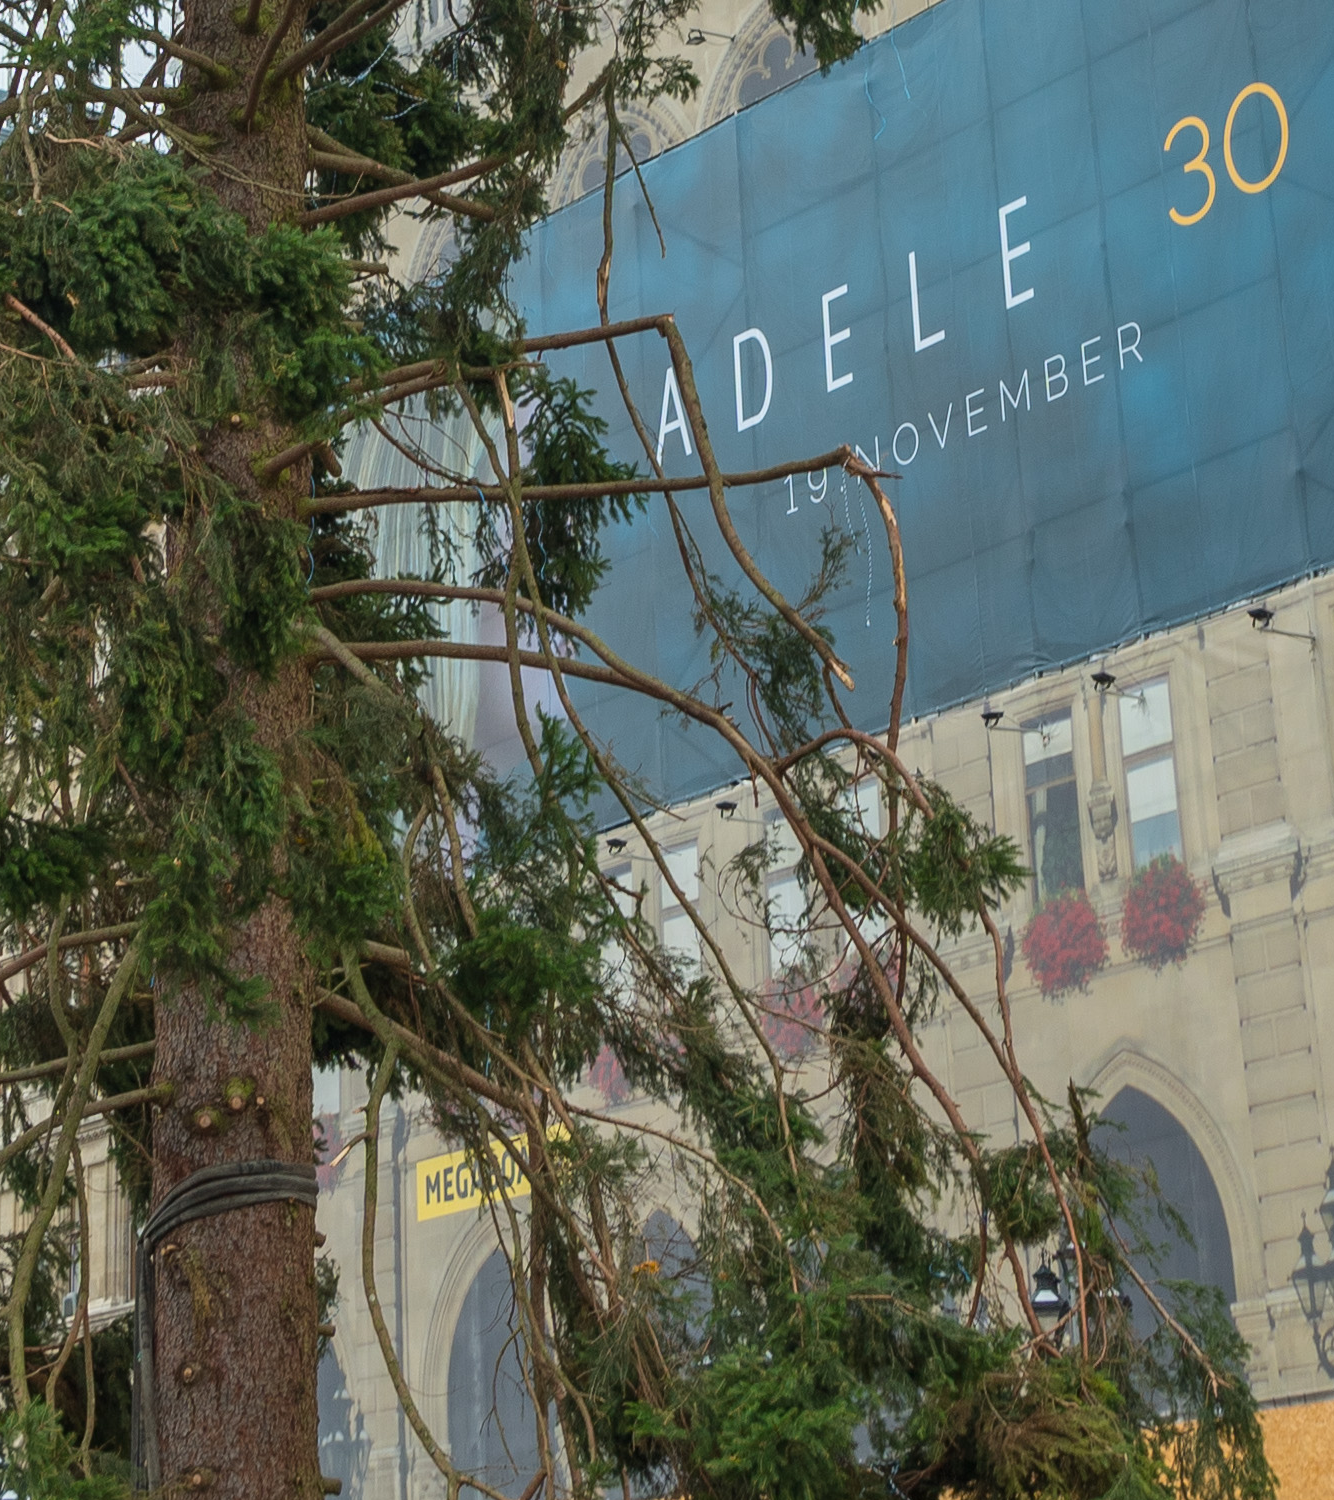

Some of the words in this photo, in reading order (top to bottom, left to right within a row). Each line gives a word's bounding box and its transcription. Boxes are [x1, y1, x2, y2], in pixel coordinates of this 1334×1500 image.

[1162, 81, 1289, 226] 30
[656, 195, 1035, 466] ADELE
[855, 321, 1143, 484] NOVEMBER
